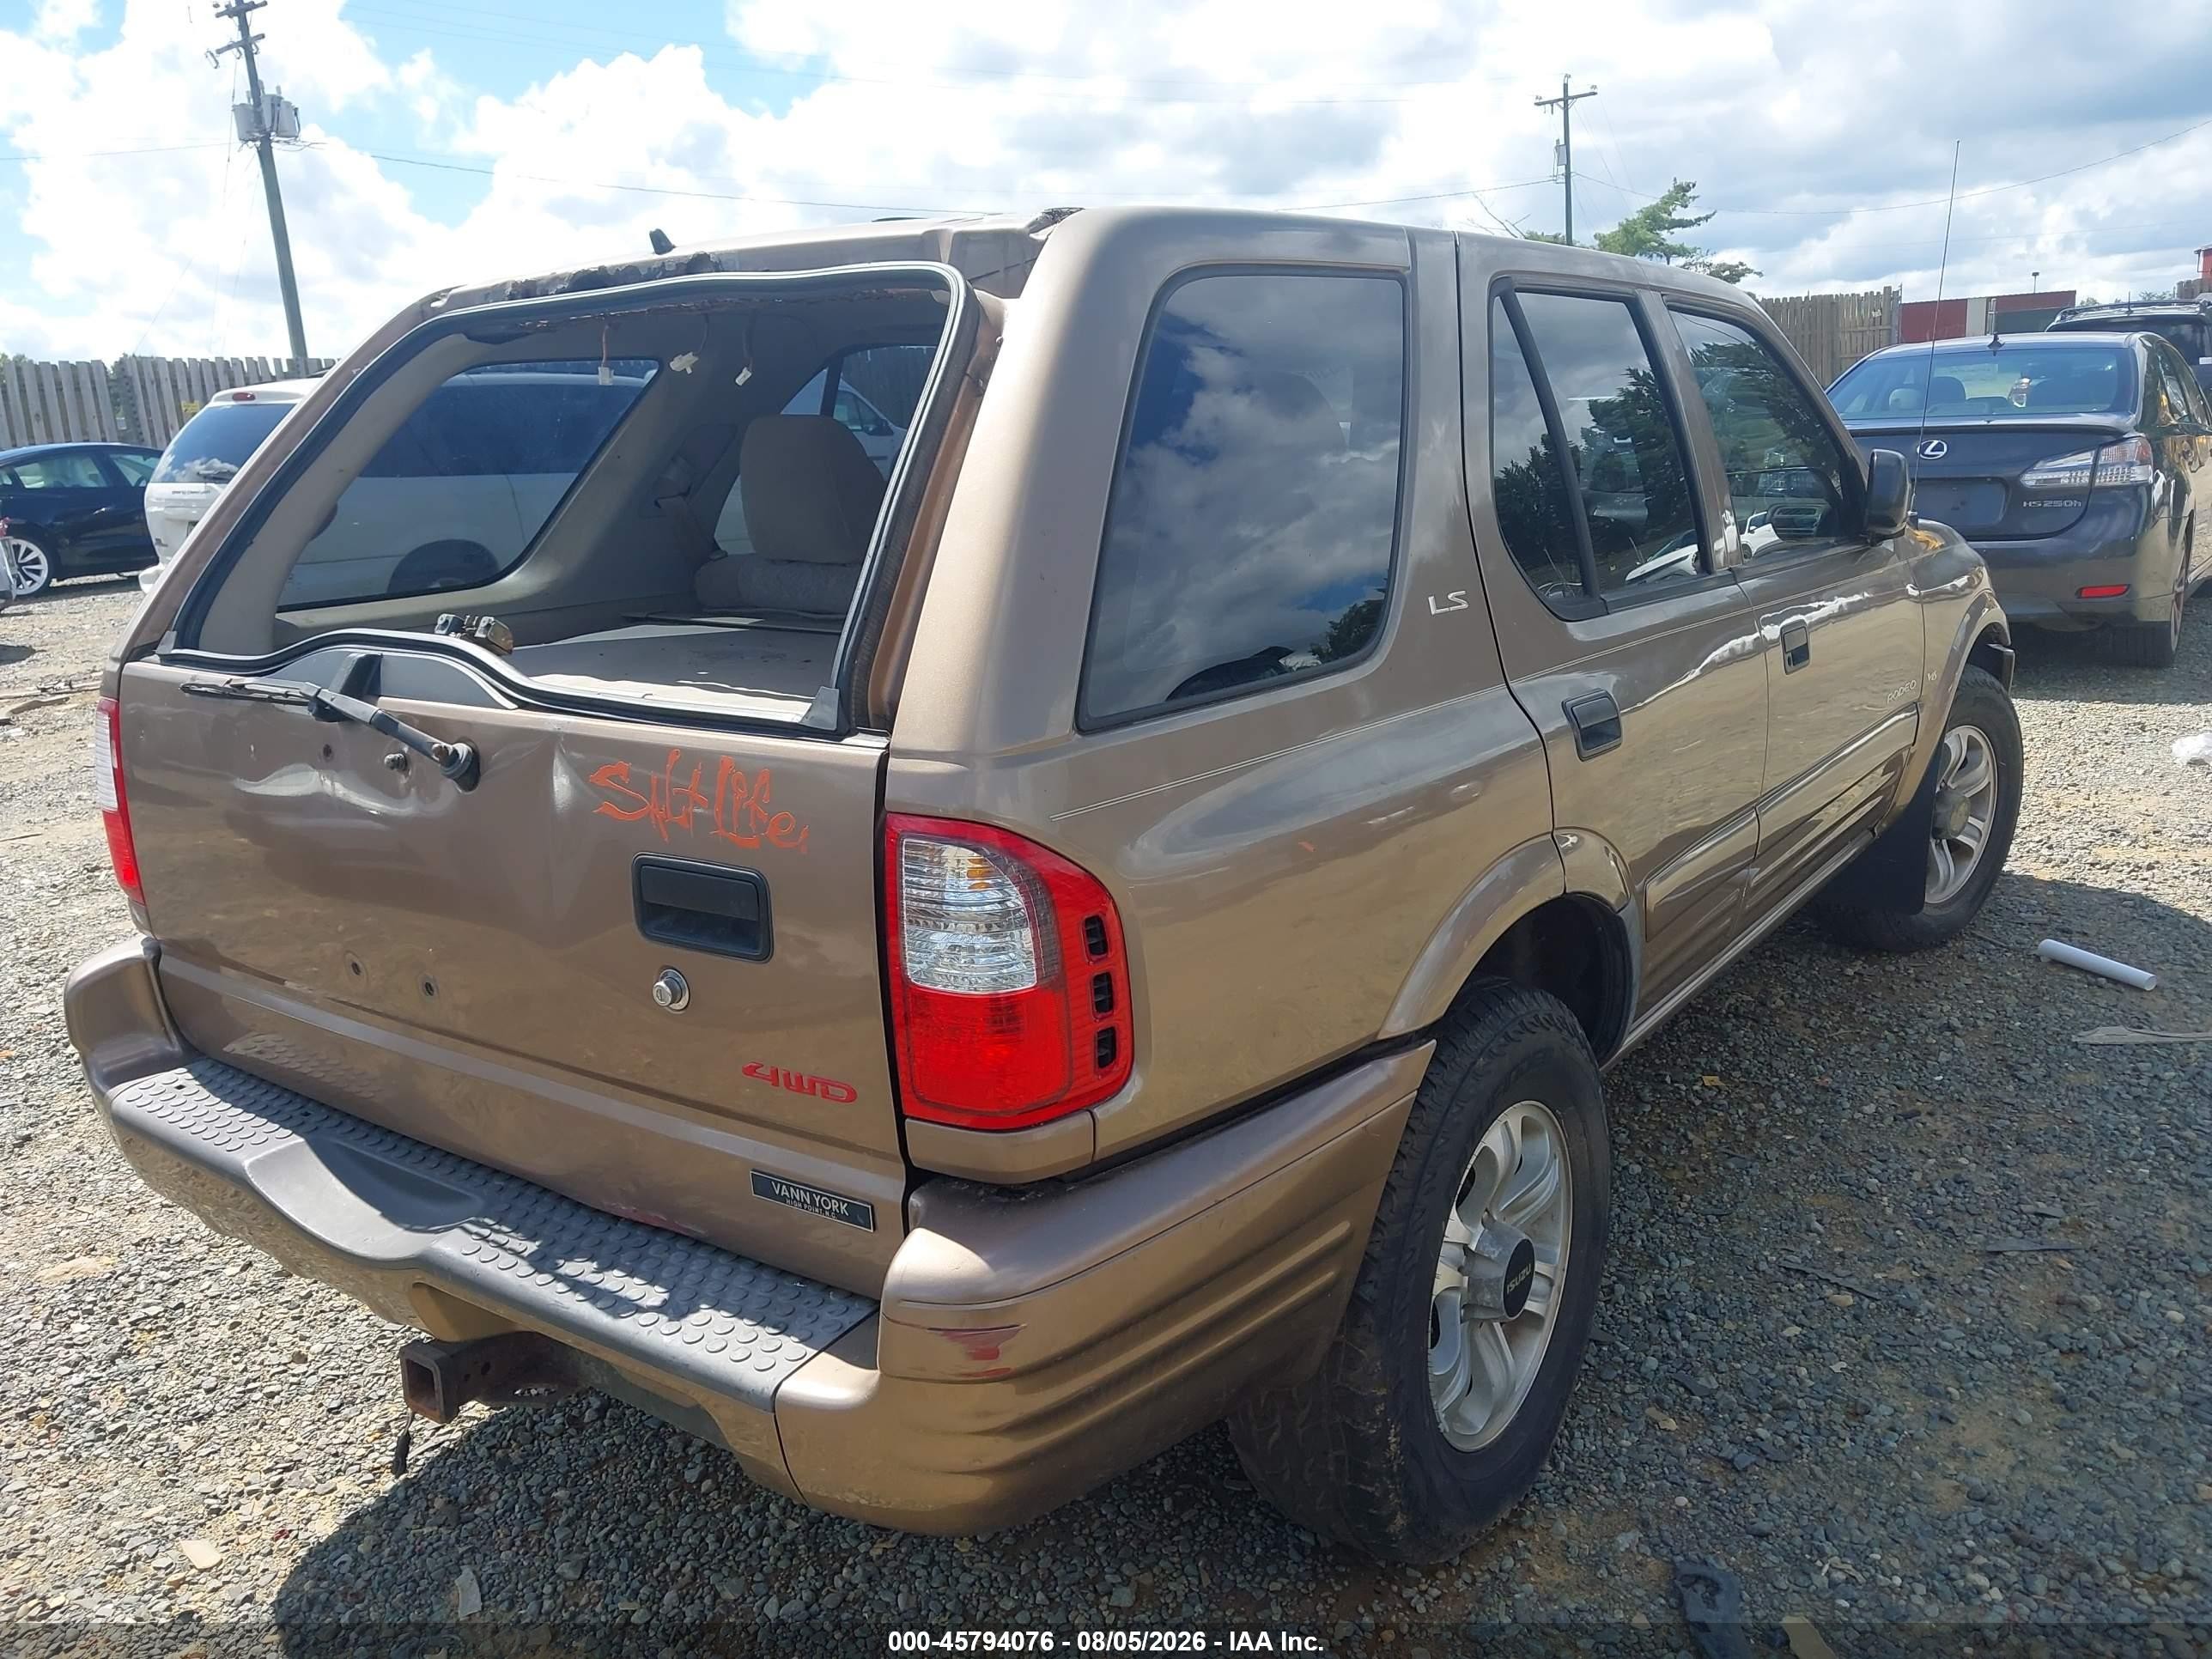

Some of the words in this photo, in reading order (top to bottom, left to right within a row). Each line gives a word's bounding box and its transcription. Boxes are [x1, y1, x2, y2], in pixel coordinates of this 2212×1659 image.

[1428, 590, 1469, 616] LS
[1887, 679, 1917, 704] RODEO
[742, 1061, 858, 1103] 4WD
[771, 1180, 811, 1206] VANN
[814, 1194, 850, 1217] YORK
[786, 1199, 802, 1210] HIGH
[1506, 1263, 1531, 1295] ISUZU
